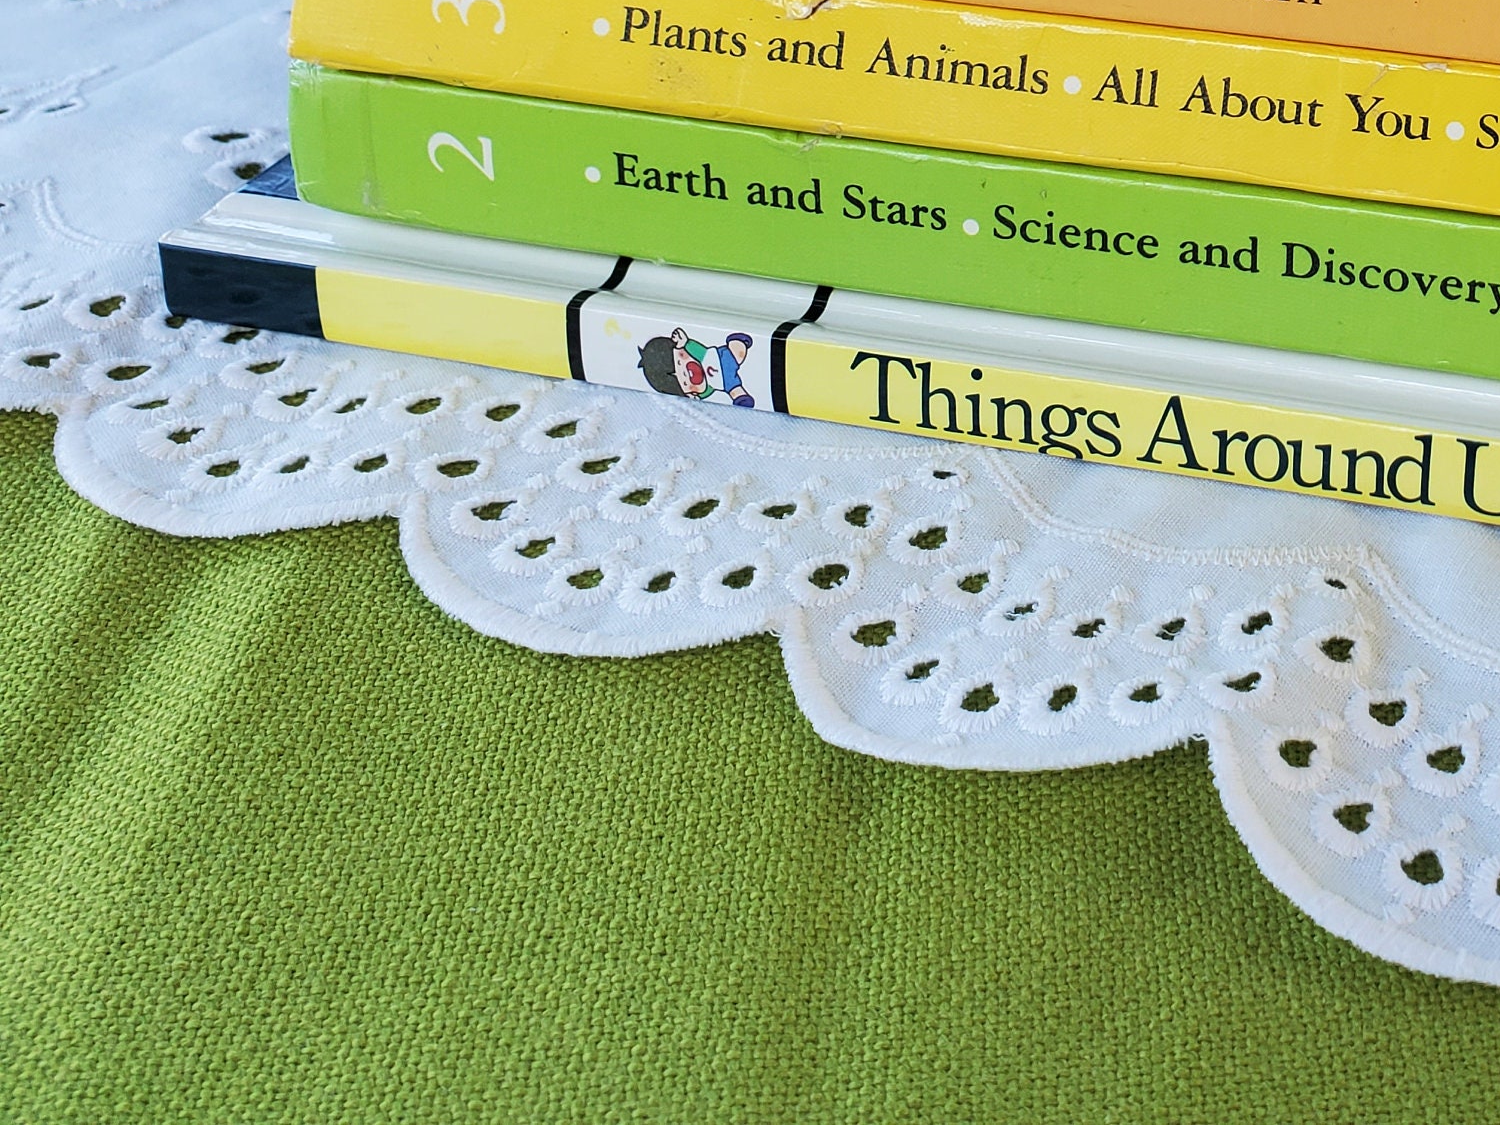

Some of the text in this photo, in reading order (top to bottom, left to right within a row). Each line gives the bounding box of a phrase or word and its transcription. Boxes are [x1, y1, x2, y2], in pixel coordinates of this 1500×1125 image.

[620, 6, 747, 57] Plants
[766, 30, 845, 71] and
[864, 36, 1050, 96] Animals
[1092, 65, 1159, 109] All
[1179, 76, 1322, 127] About
[1346, 92, 1432, 142] You
[427, 131, 495, 181] 2
[613, 152, 728, 201] Earth
[747, 177, 823, 214] and
[842, 184, 948, 231] Stars
[992, 204, 1159, 259] Science
[1178, 236, 1260, 273] and
[850, 351, 1122, 460] Things
[1137, 396, 1436, 507] Around
